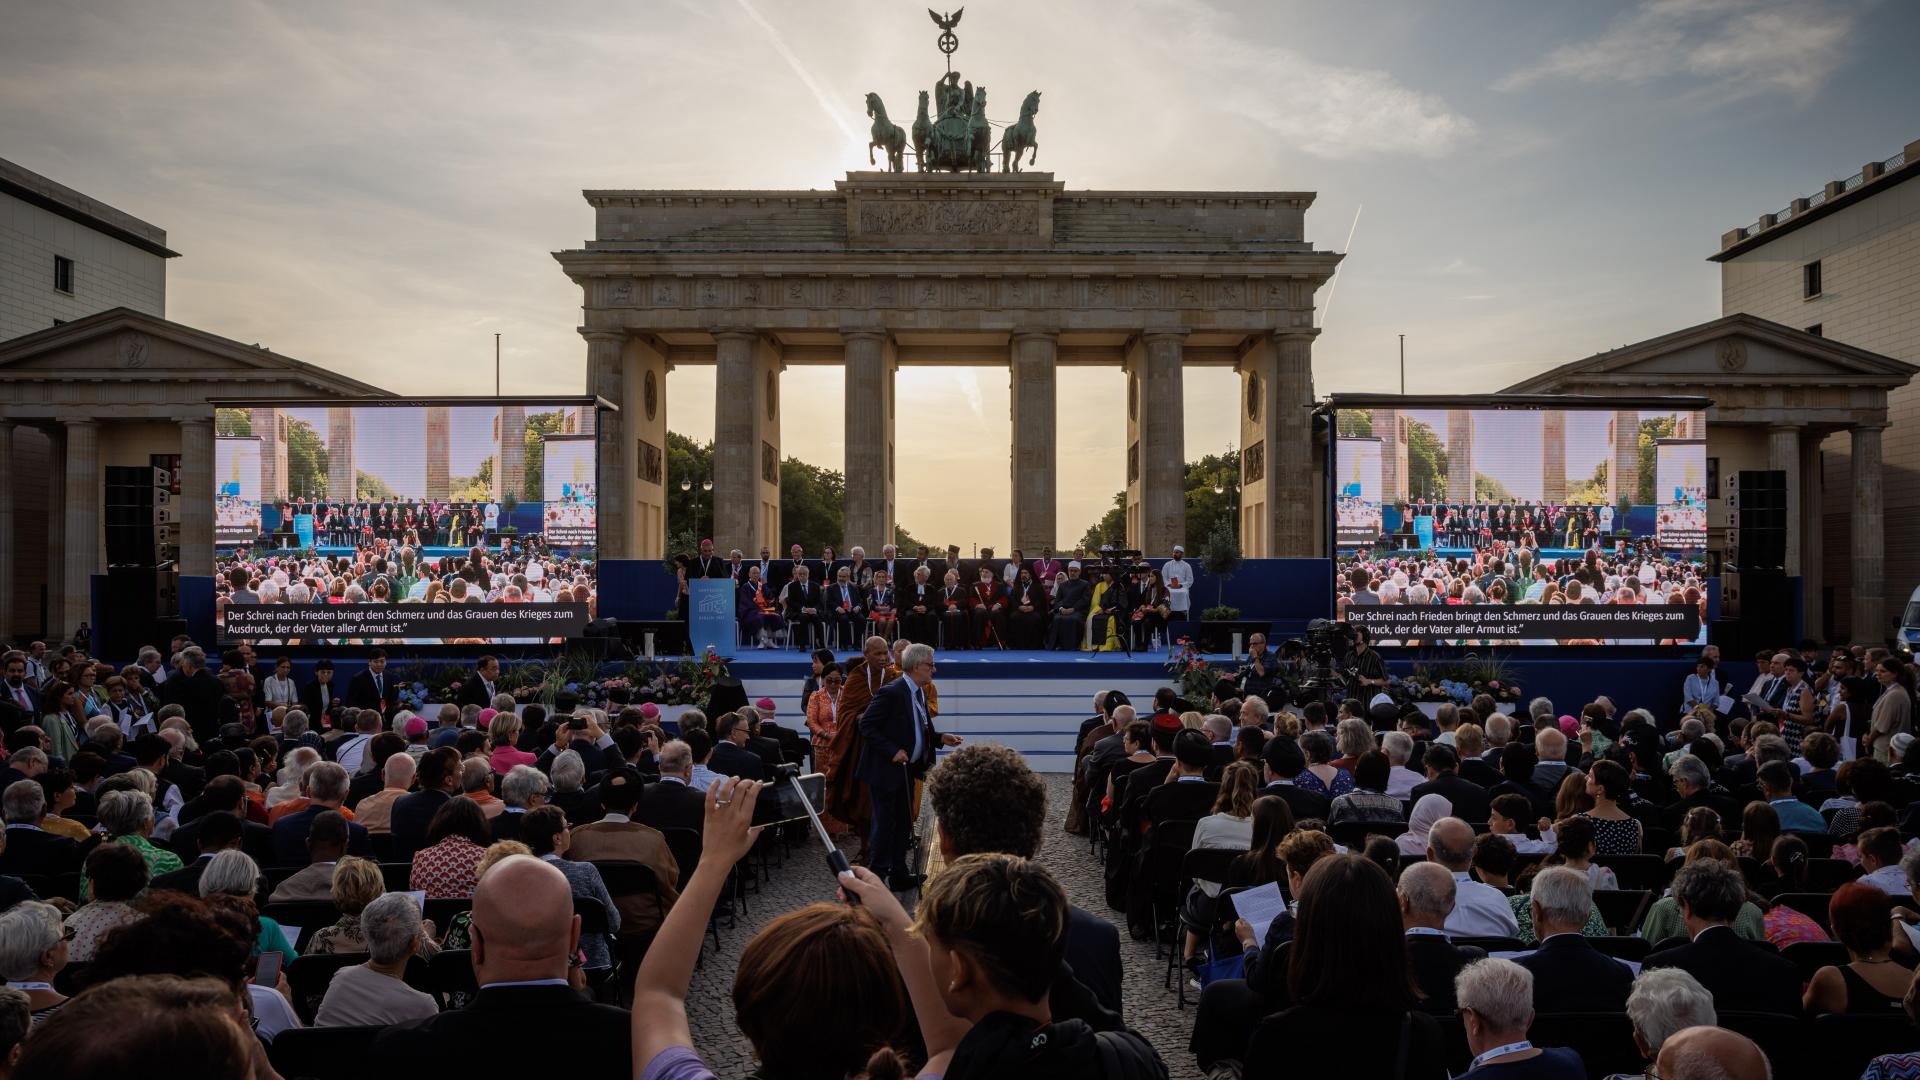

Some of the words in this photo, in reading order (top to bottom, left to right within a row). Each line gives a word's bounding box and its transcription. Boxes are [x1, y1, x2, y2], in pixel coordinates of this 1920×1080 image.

[227, 611, 244, 621] Der
[246, 611, 274, 620] Schrei
[276, 610, 299, 620] nach
[301, 610, 335, 620] Frieden
[337, 610, 364, 622] bringt
[367, 610, 384, 620] den
[386, 610, 424, 620] Schmerz
[427, 610, 444, 619] und
[447, 610, 463, 619] das
[465, 610, 499, 619] Grauen
[500, 610, 517, 619] des
[519, 610, 552, 621] Krieges
[1348, 611, 1365, 621] Der
[1366, 611, 1394, 621] Schrei
[1396, 611, 1418, 621] nach
[1420, 611, 1453, 620] Frieden
[1456, 611, 1482, 623] bringt
[1484, 611, 1501, 621] den
[1503, 611, 1541, 621] Schmerz
[1543, 611, 1560, 621] und
[1562, 611, 1578, 621] das
[1580, 611, 1612, 621] Grauen
[1614, 611, 1630, 621] des
[1632, 611, 1664, 623] Krieges
[1665, 613, 1685, 621] zum
[227, 624, 273, 635] Ausdruck,
[275, 624, 291, 634] der
[293, 624, 309, 634] der
[310, 624, 335, 633] Vater
[337, 623, 358, 633] aller
[359, 624, 389, 633] Armut
[1394, 624, 1411, 634] der
[1412, 624, 1428, 634] der
[1430, 624, 1454, 634] Vater
[1455, 624, 1475, 634] aller
[1476, 624, 1505, 634] Armut
